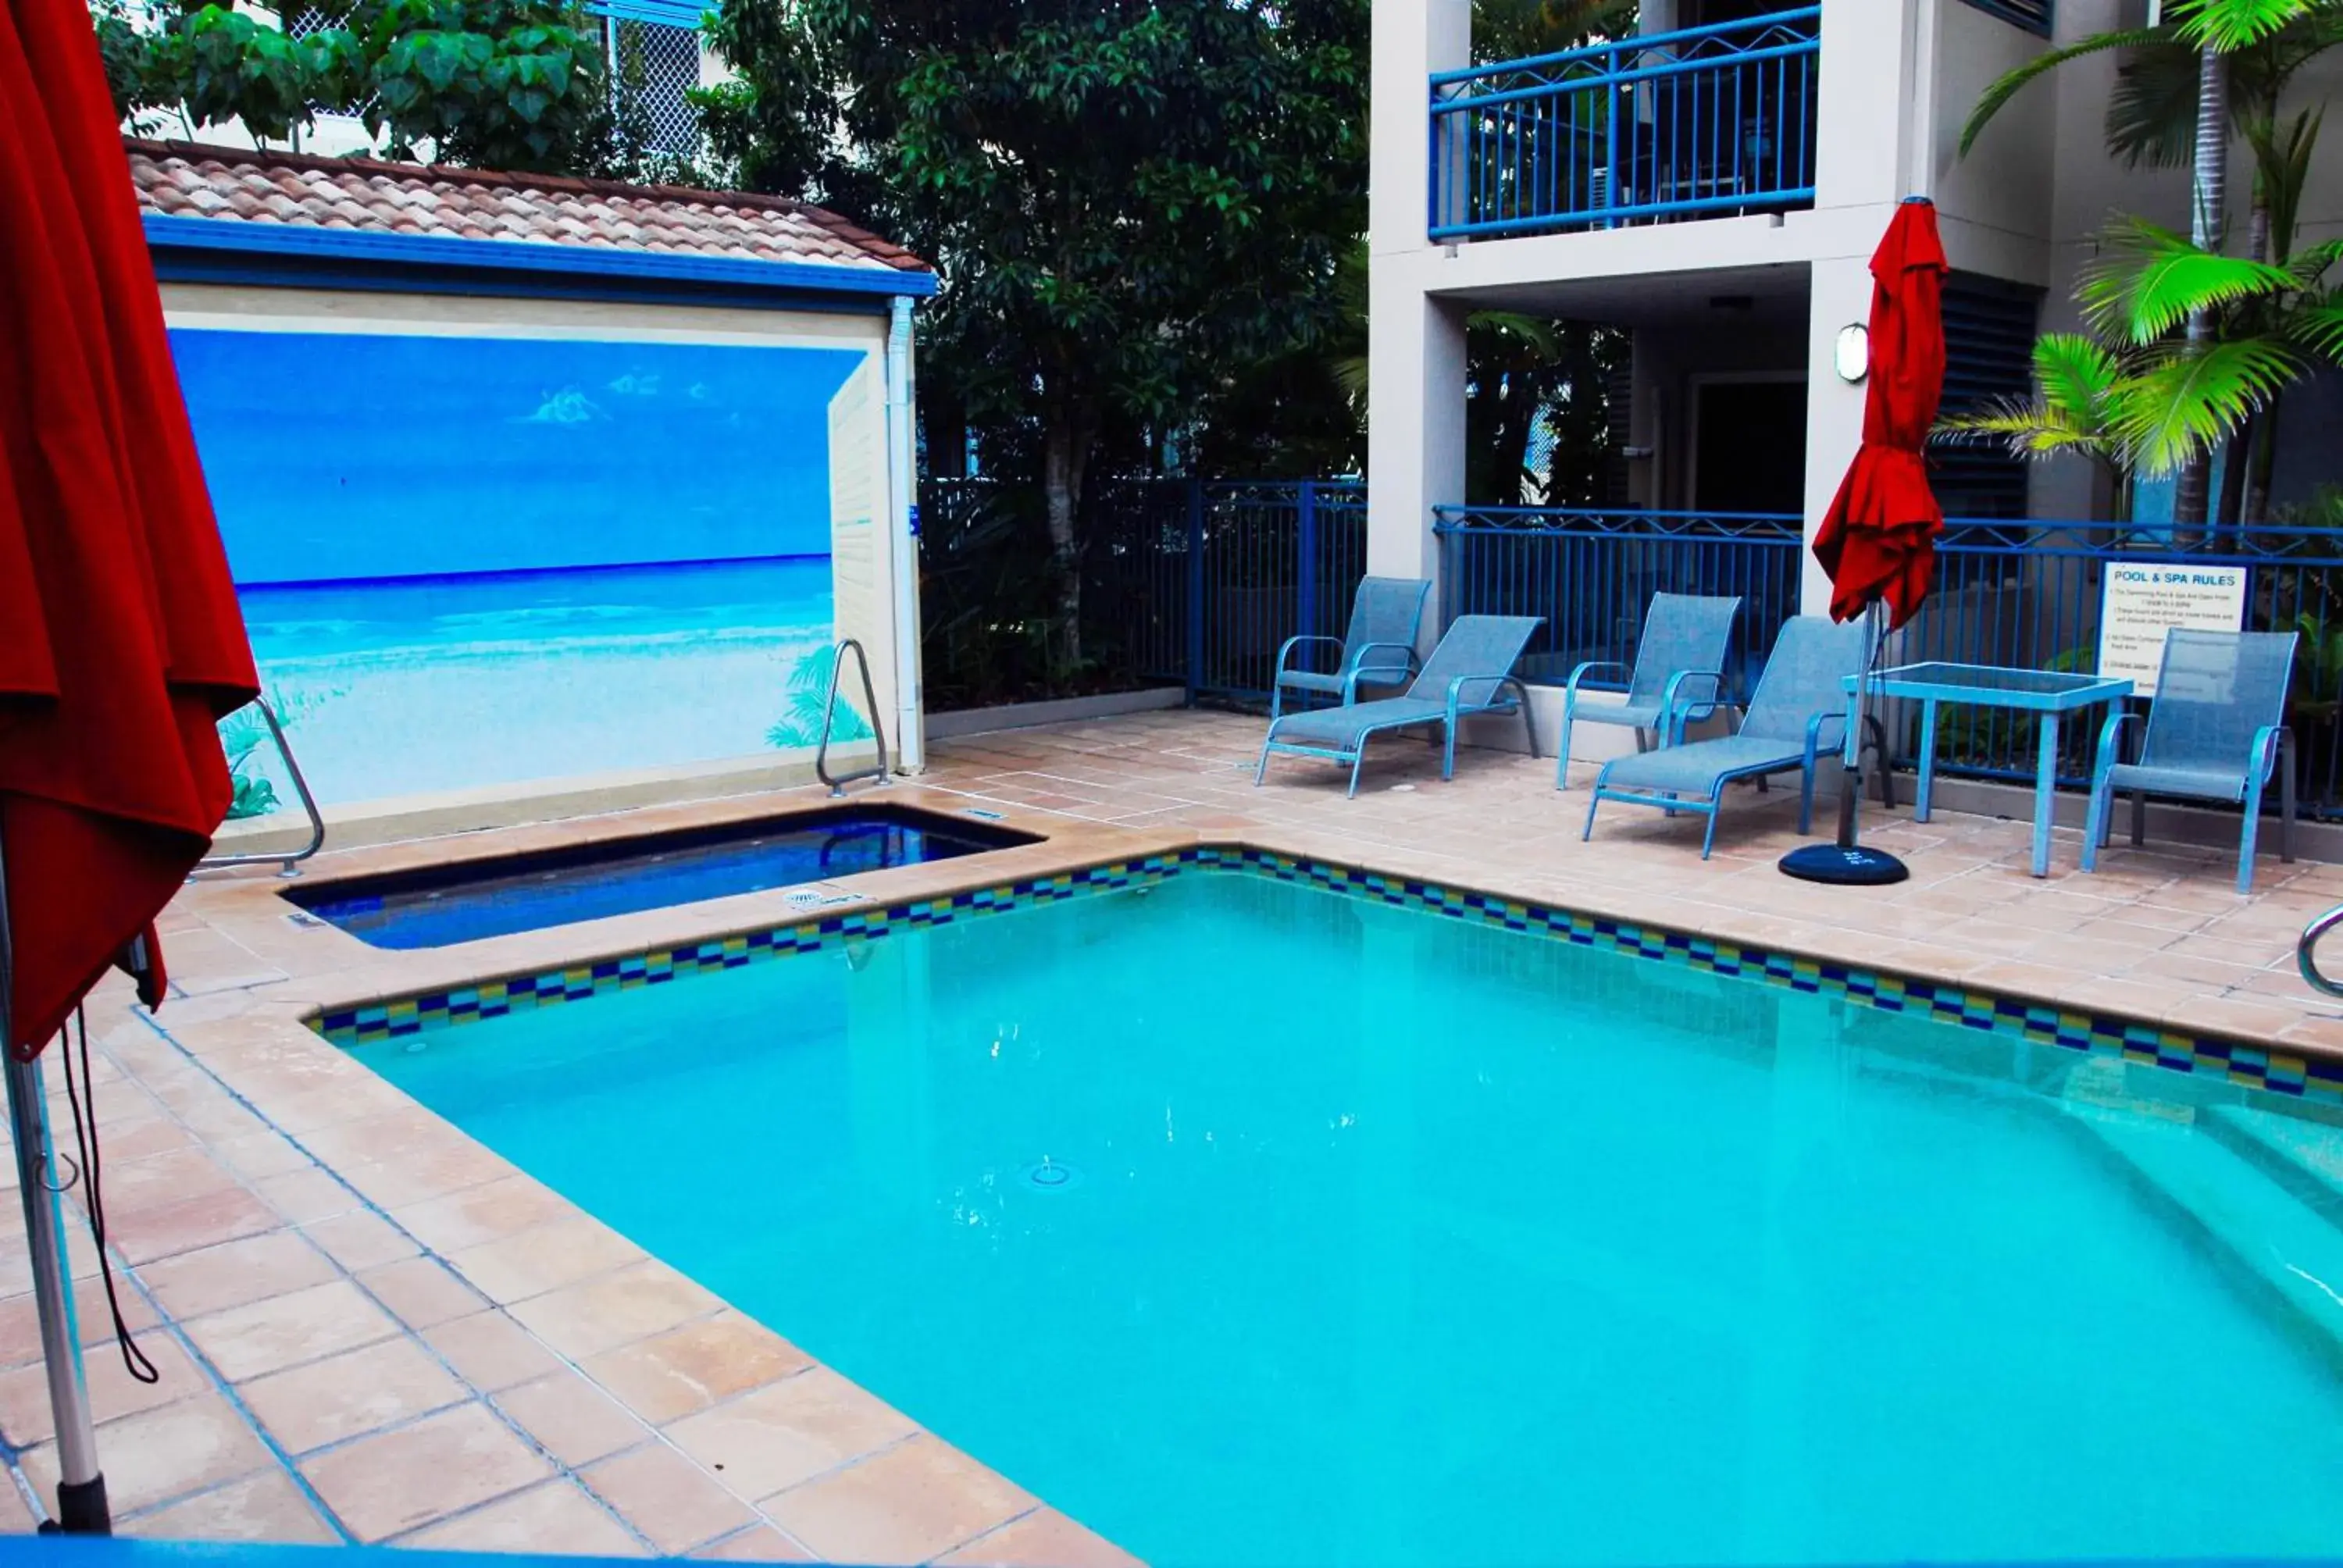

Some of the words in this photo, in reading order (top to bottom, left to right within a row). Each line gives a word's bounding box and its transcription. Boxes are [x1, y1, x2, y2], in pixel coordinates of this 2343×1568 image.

[2114, 571, 2149, 582] POOL
[2152, 572, 2160, 583] &
[2164, 573, 2188, 584] SPA
[2192, 574, 2235, 586] RULES
